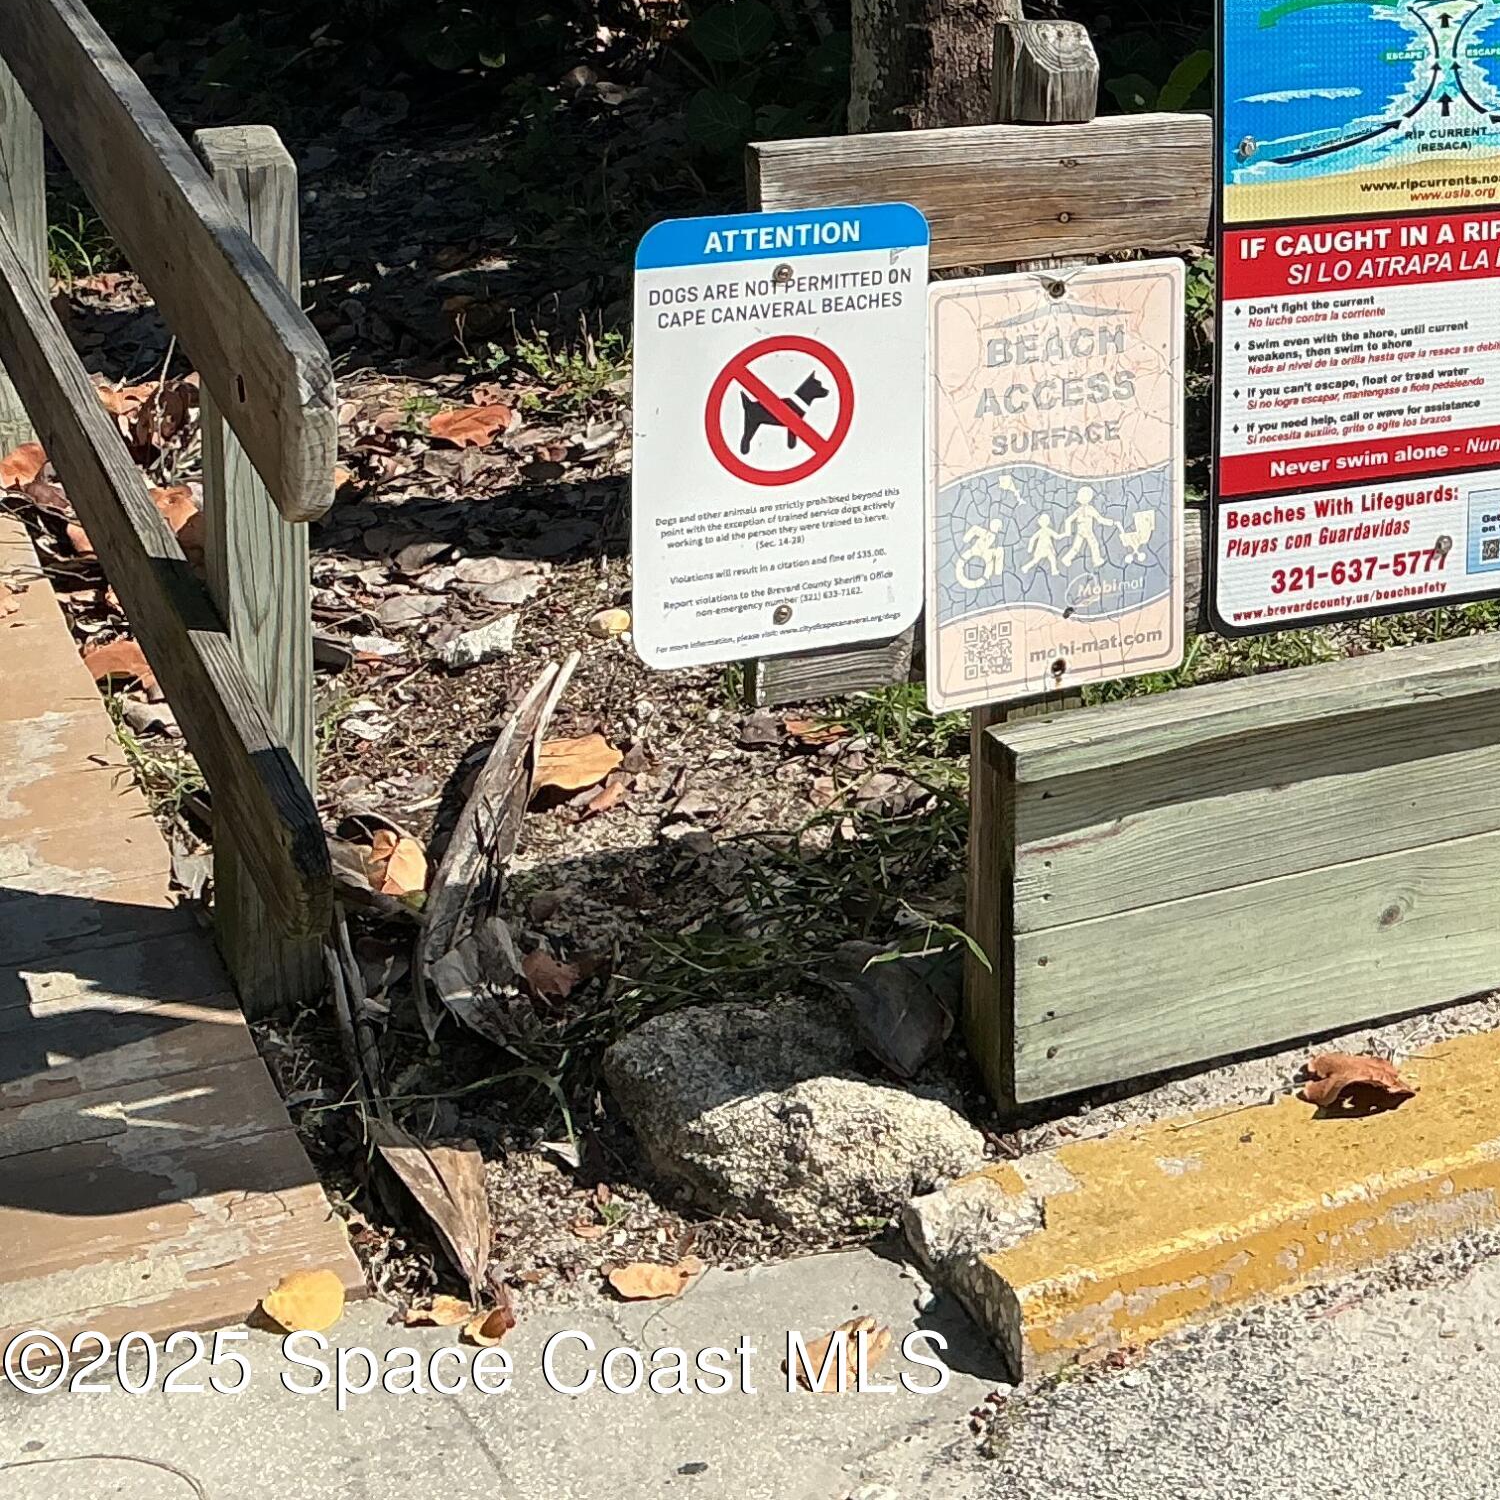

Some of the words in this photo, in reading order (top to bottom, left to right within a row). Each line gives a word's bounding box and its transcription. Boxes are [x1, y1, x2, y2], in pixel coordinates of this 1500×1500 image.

[1386, 51, 1423, 61] ESCAPE
[1405, 129, 1426, 140] RIP
[1430, 127, 1487, 139] CURRENT
[1417, 141, 1472, 153] (RESACA)
[1410, 186, 1496, 201] www.usla.org
[704, 220, 860, 254] ATTENTION
[1241, 238, 1265, 260] IF
[1274, 227, 1392, 257] CAUGHT
[1400, 224, 1430, 247] IN
[1437, 223, 1459, 244] A
[1287, 263, 1311, 285] SI
[1317, 260, 1351, 282] LO
[1356, 252, 1454, 280] ATRAPA
[1459, 249, 1489, 271] LA
[650, 286, 698, 306] DOGS
[703, 282, 738, 301] ARE
[745, 280, 779, 298] NOT
[785, 270, 882, 293] PERMITTED
[888, 268, 912, 284] ON
[658, 311, 706, 329] CAPE
[712, 301, 816, 324] CANAVERAL
[822, 292, 902, 312] BEACHES
[1249, 302, 1279, 315] Don't
[1282, 301, 1308, 314] fight
[1311, 300, 1329, 309] the
[1333, 296, 1375, 308] current
[987, 324, 1125, 368] BEACH
[1248, 340, 1279, 351] Swim
[1283, 338, 1310, 348] even
[1313, 333, 1338, 343] with
[1341, 331, 1359, 341] the
[1363, 328, 1397, 340] shore,
[1401, 325, 1425, 335] until
[1428, 321, 1468, 333] current
[974, 370, 1137, 419] ACCESS
[992, 421, 1120, 456] SURFACE
[1270, 458, 1328, 478] Never
[1336, 451, 1389, 470] swim
[1395, 444, 1448, 463] alone
[1227, 508, 1306, 530] Beaches
[1315, 499, 1353, 518] With
[1361, 486, 1459, 513] Lifeguards:
[1482, 514, 1500, 523] Get
[1227, 534, 1277, 558] Playas
[1285, 531, 1312, 548] con
[1318, 518, 1410, 545] Guardavidas
[670, 573, 713, 585] Violations
[716, 569, 731, 578] will
[733, 566, 757, 575] result
[760, 564, 768, 573] in
[777, 559, 810, 570] citation
[811, 557, 827, 566] and
[829, 554, 844, 563] fine
[847, 552, 855, 560] of
[1271, 545, 1450, 594] 321-637-5777
[1233, 581, 1447, 622] www.brevardcounty.us/beachsafety
[1030, 629, 1163, 664] mobi-mat.com
